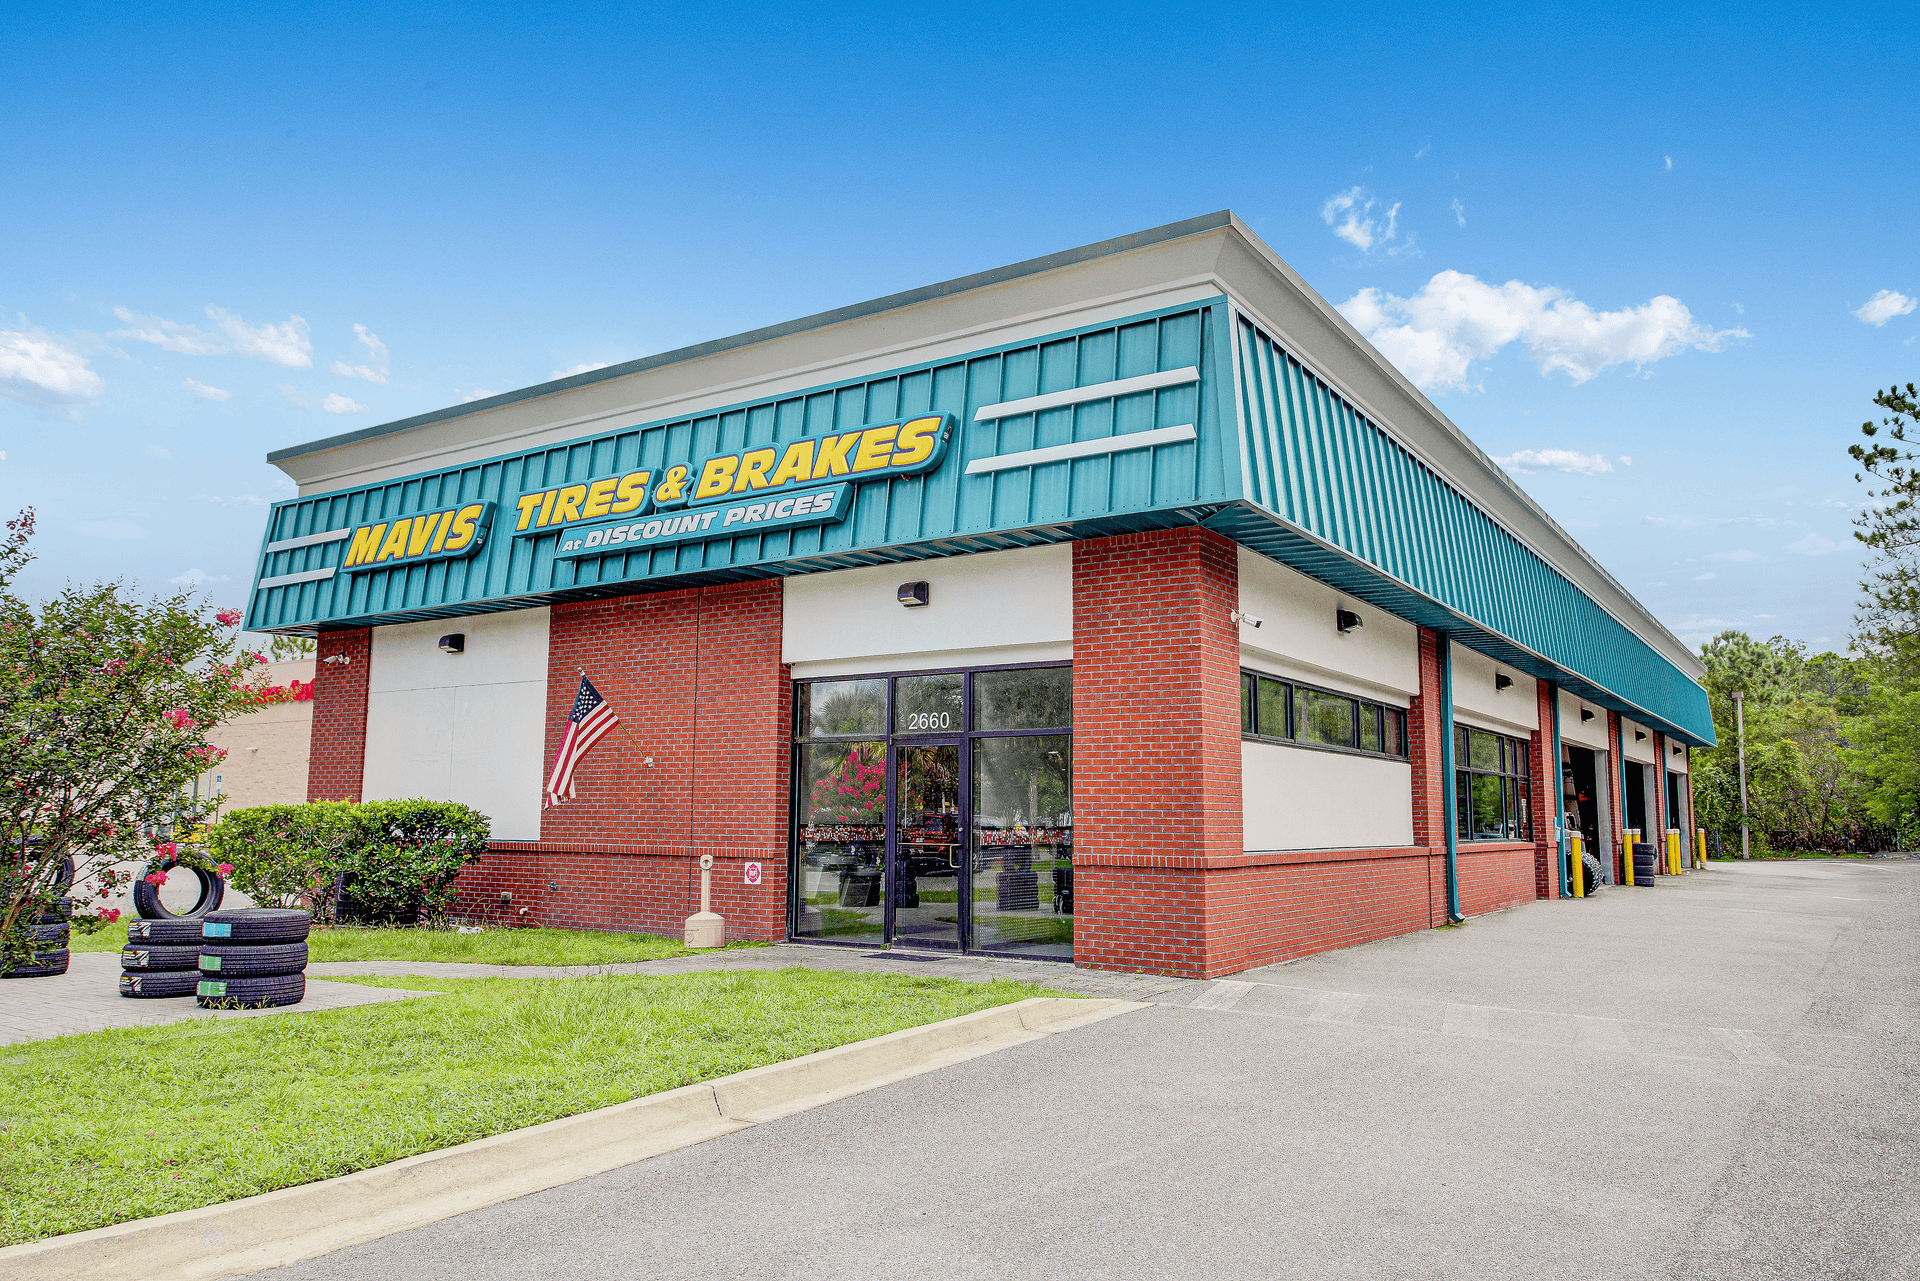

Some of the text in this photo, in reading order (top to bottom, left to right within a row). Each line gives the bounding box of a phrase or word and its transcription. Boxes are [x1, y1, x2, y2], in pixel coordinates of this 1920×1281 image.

[344, 416, 942, 567] MAVIS TIRES & BRAKES
[561, 491, 836, 552] At DISCOUNT PRICES
[908, 712, 949, 729] 2660
